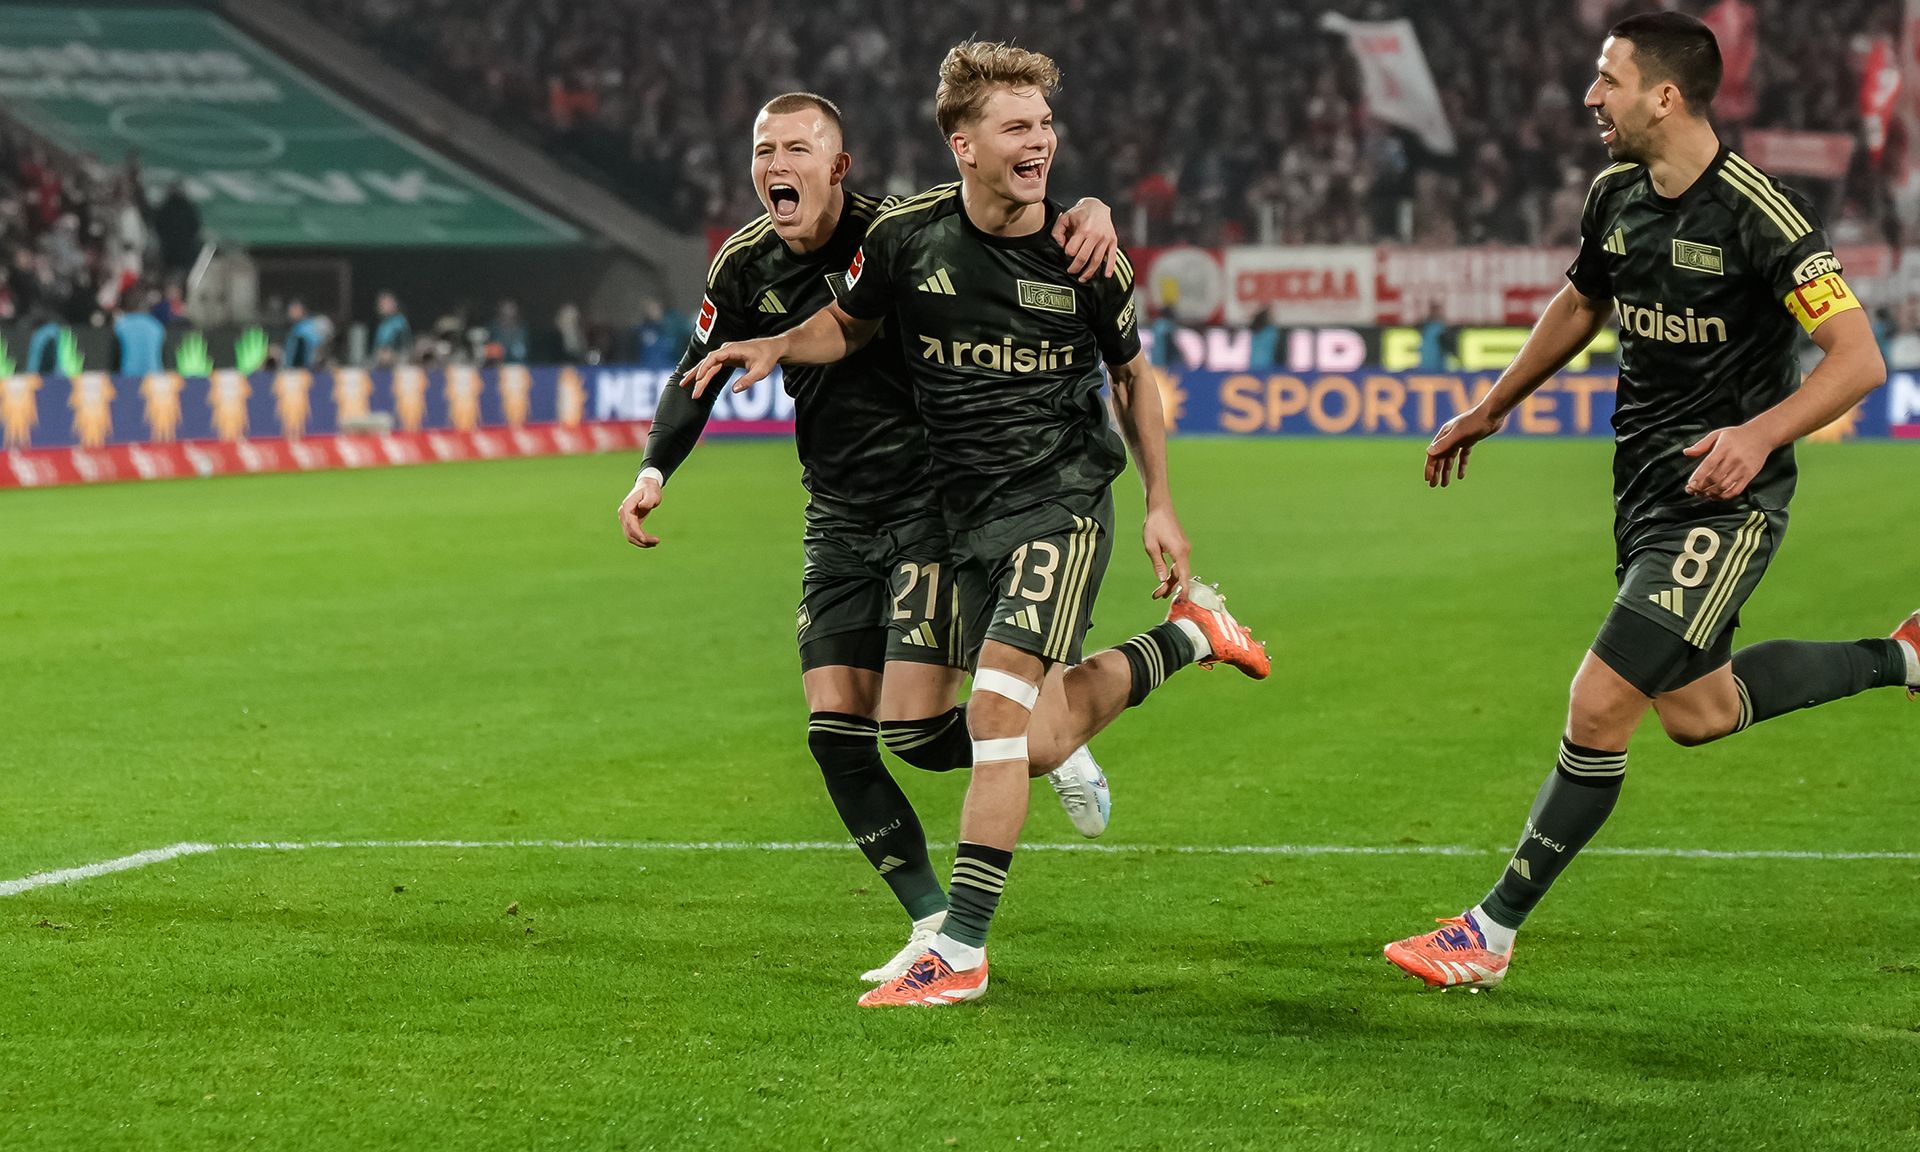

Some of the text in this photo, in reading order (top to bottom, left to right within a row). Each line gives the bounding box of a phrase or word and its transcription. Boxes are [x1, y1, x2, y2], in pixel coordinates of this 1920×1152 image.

[1623, 302, 1727, 344] raisin
[952, 337, 1075, 373] raisin
[1219, 374, 1618, 433] SPORTET
[1007, 541, 1061, 602] 13
[1672, 526, 1721, 588] 8
[892, 562, 941, 621] 21
